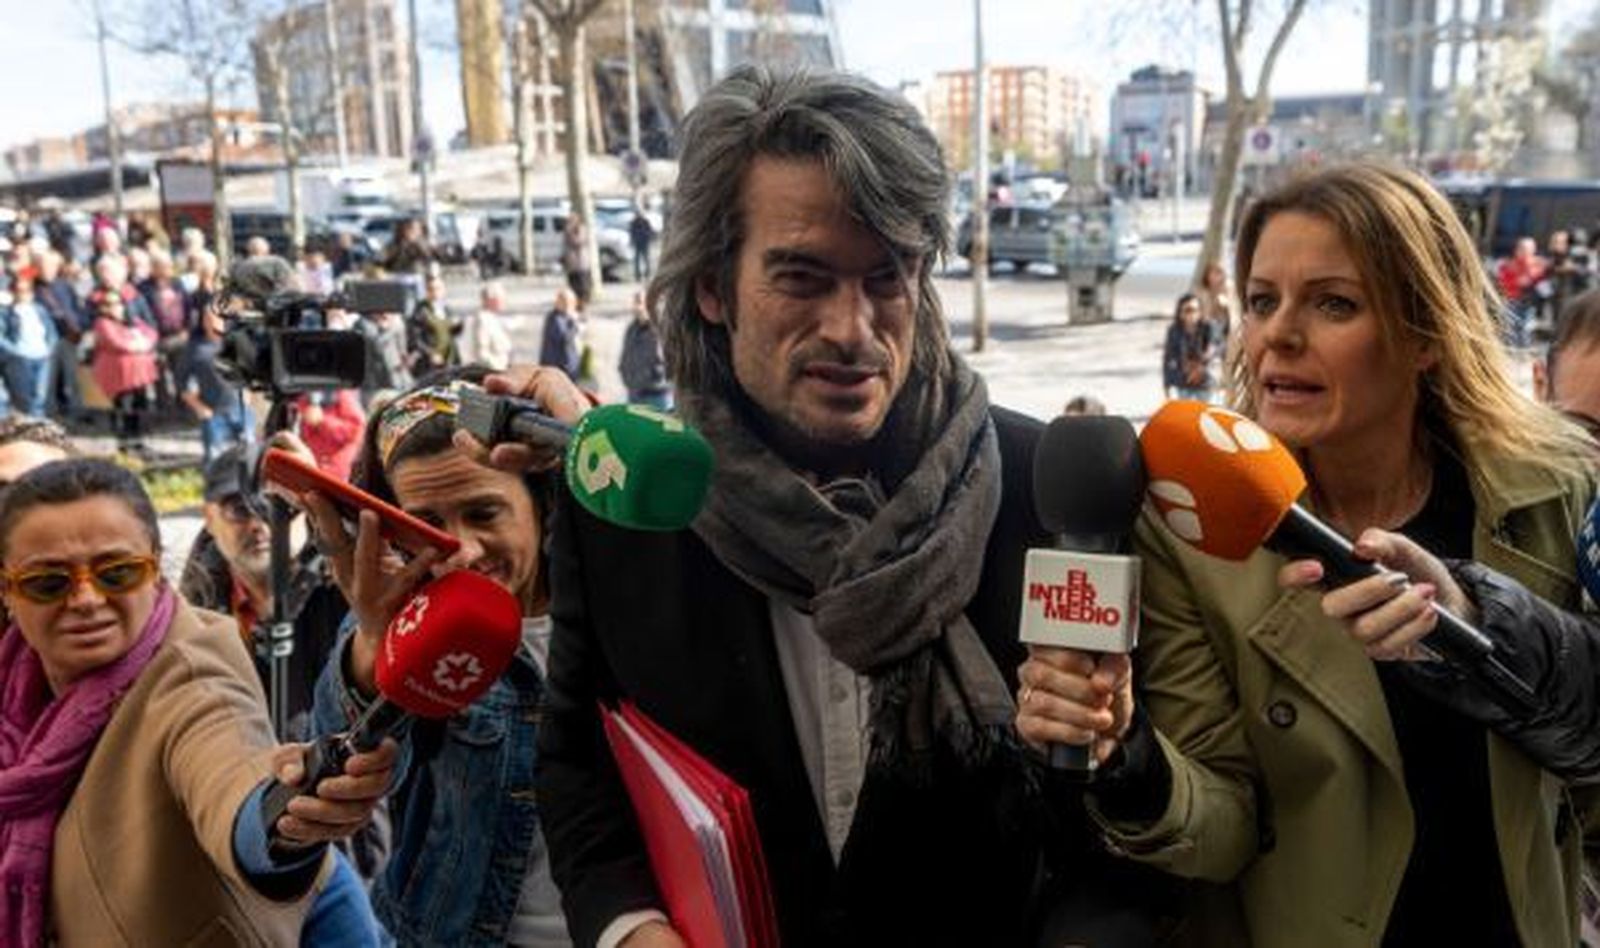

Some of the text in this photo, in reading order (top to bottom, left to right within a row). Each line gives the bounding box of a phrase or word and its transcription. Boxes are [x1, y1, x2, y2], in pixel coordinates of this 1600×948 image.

[1067, 569, 1087, 588] EL
[1029, 582, 1097, 606] INTER
[1043, 601, 1120, 626] MEDIO
